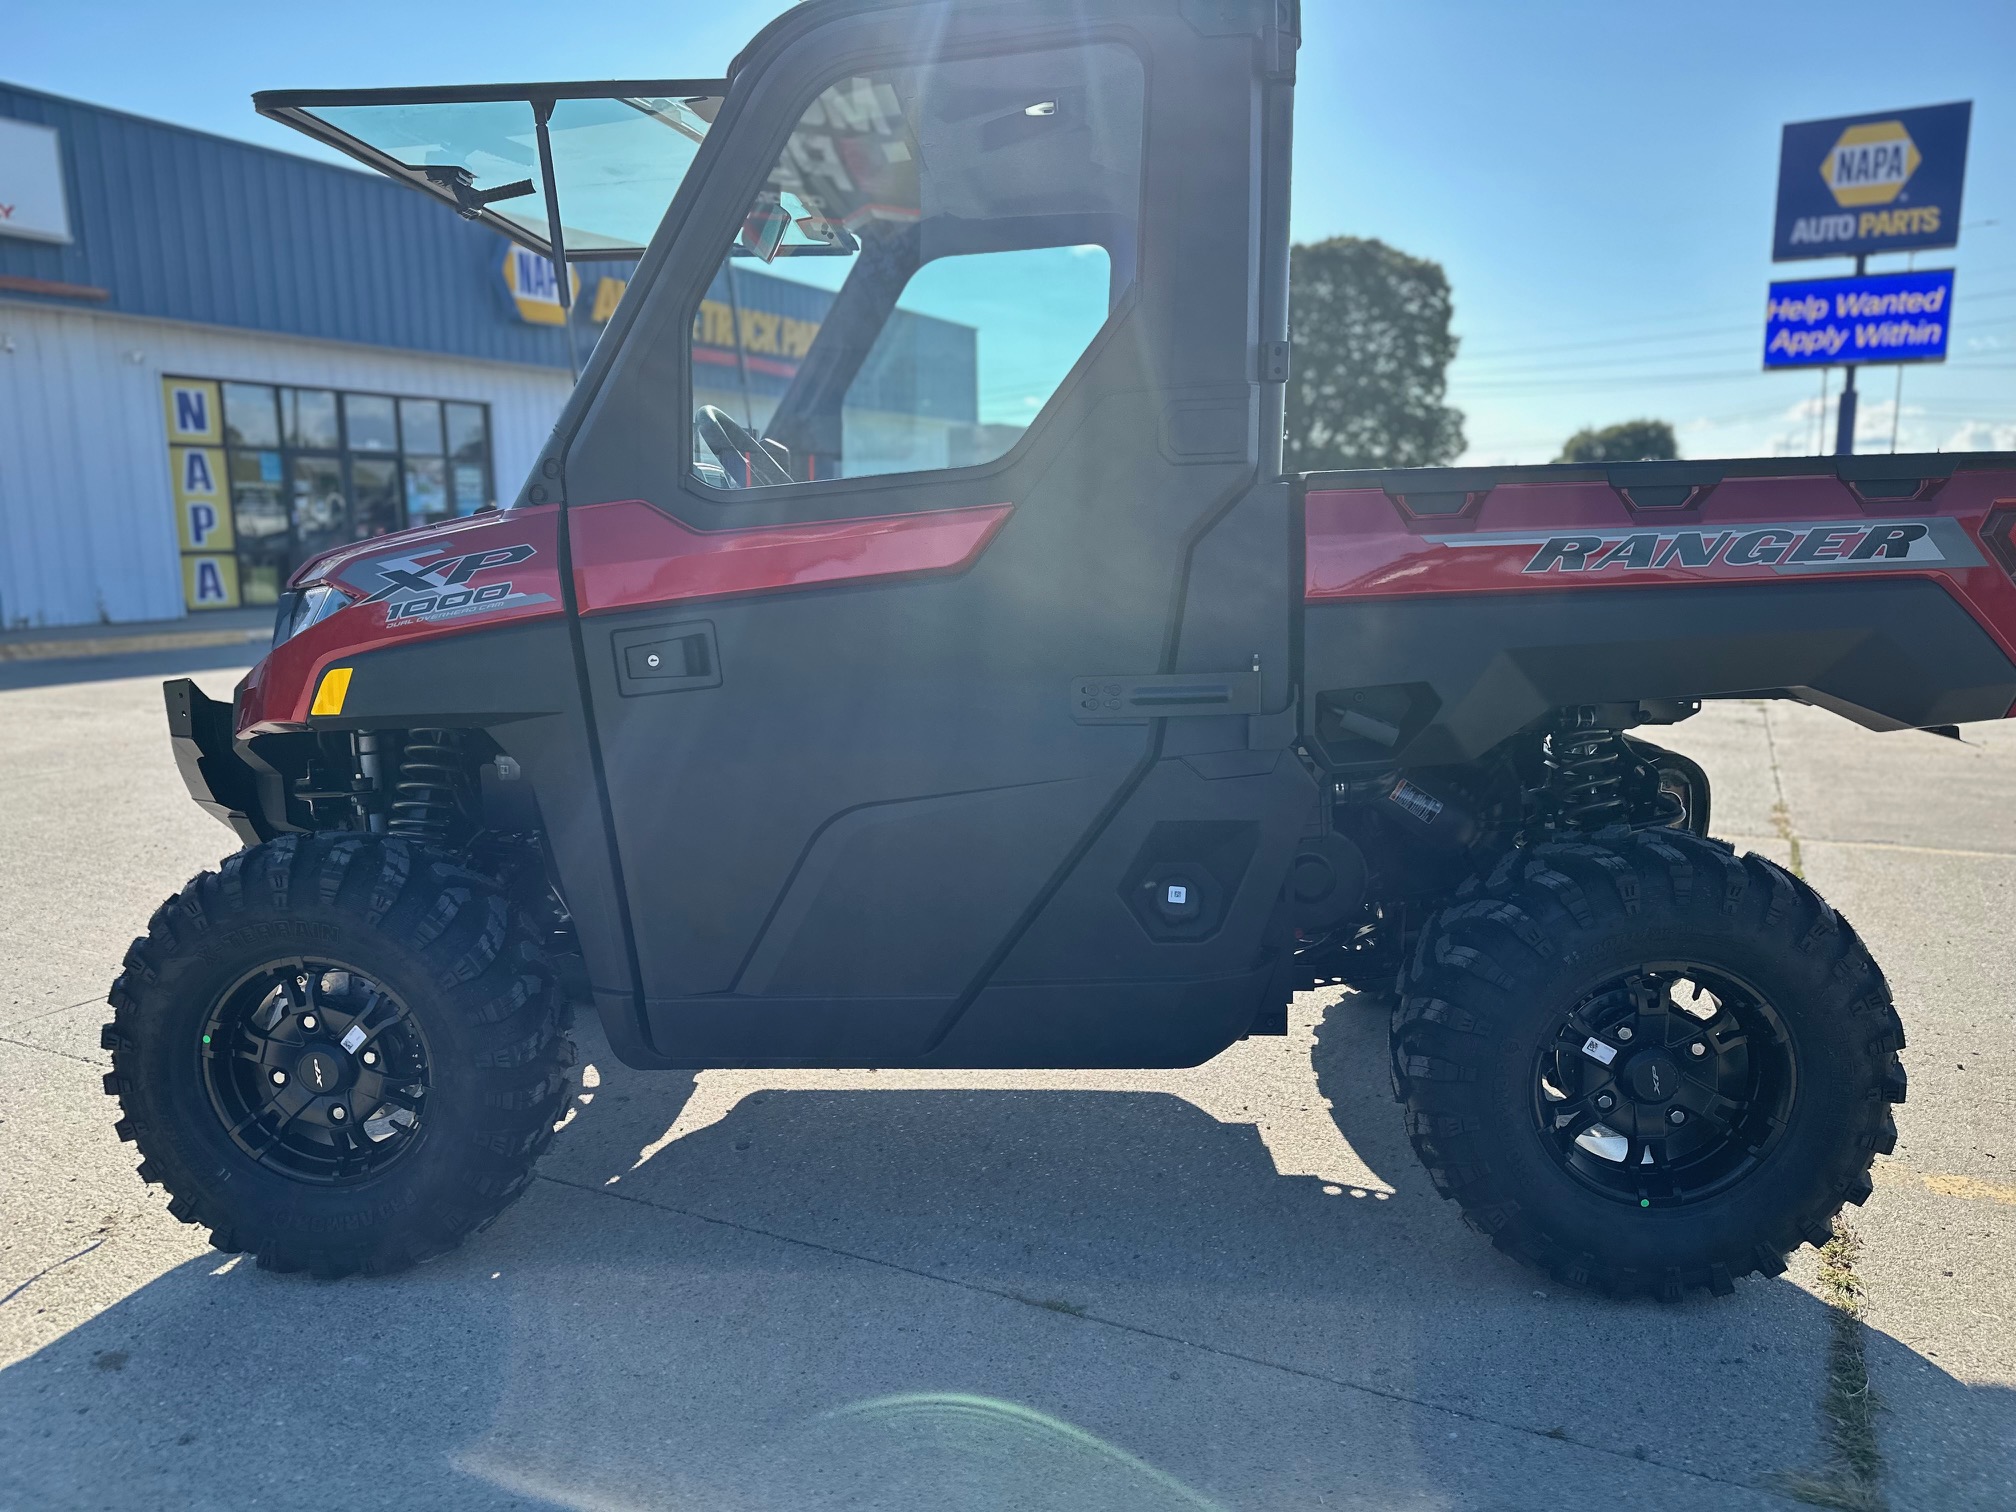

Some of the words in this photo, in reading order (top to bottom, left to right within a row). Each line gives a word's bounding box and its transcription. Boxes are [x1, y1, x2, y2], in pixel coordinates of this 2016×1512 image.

[1836, 144, 1904, 184] NAPA
[1790, 214, 1855, 244] AUTO
[1858, 206, 1941, 239] PARTS
[1767, 294, 1829, 325] Help
[1836, 285, 1946, 319] Wanted
[1768, 324, 1849, 357] Apply
[1854, 318, 1942, 349] Within
[1520, 523, 1929, 574] RANGER
[351, 543, 538, 608] XP
[385, 581, 513, 623] 1000
[386, 619, 414, 629] DUAL
[416, 607, 477, 623] OVERHEAD
[478, 601, 505, 611] CAM
